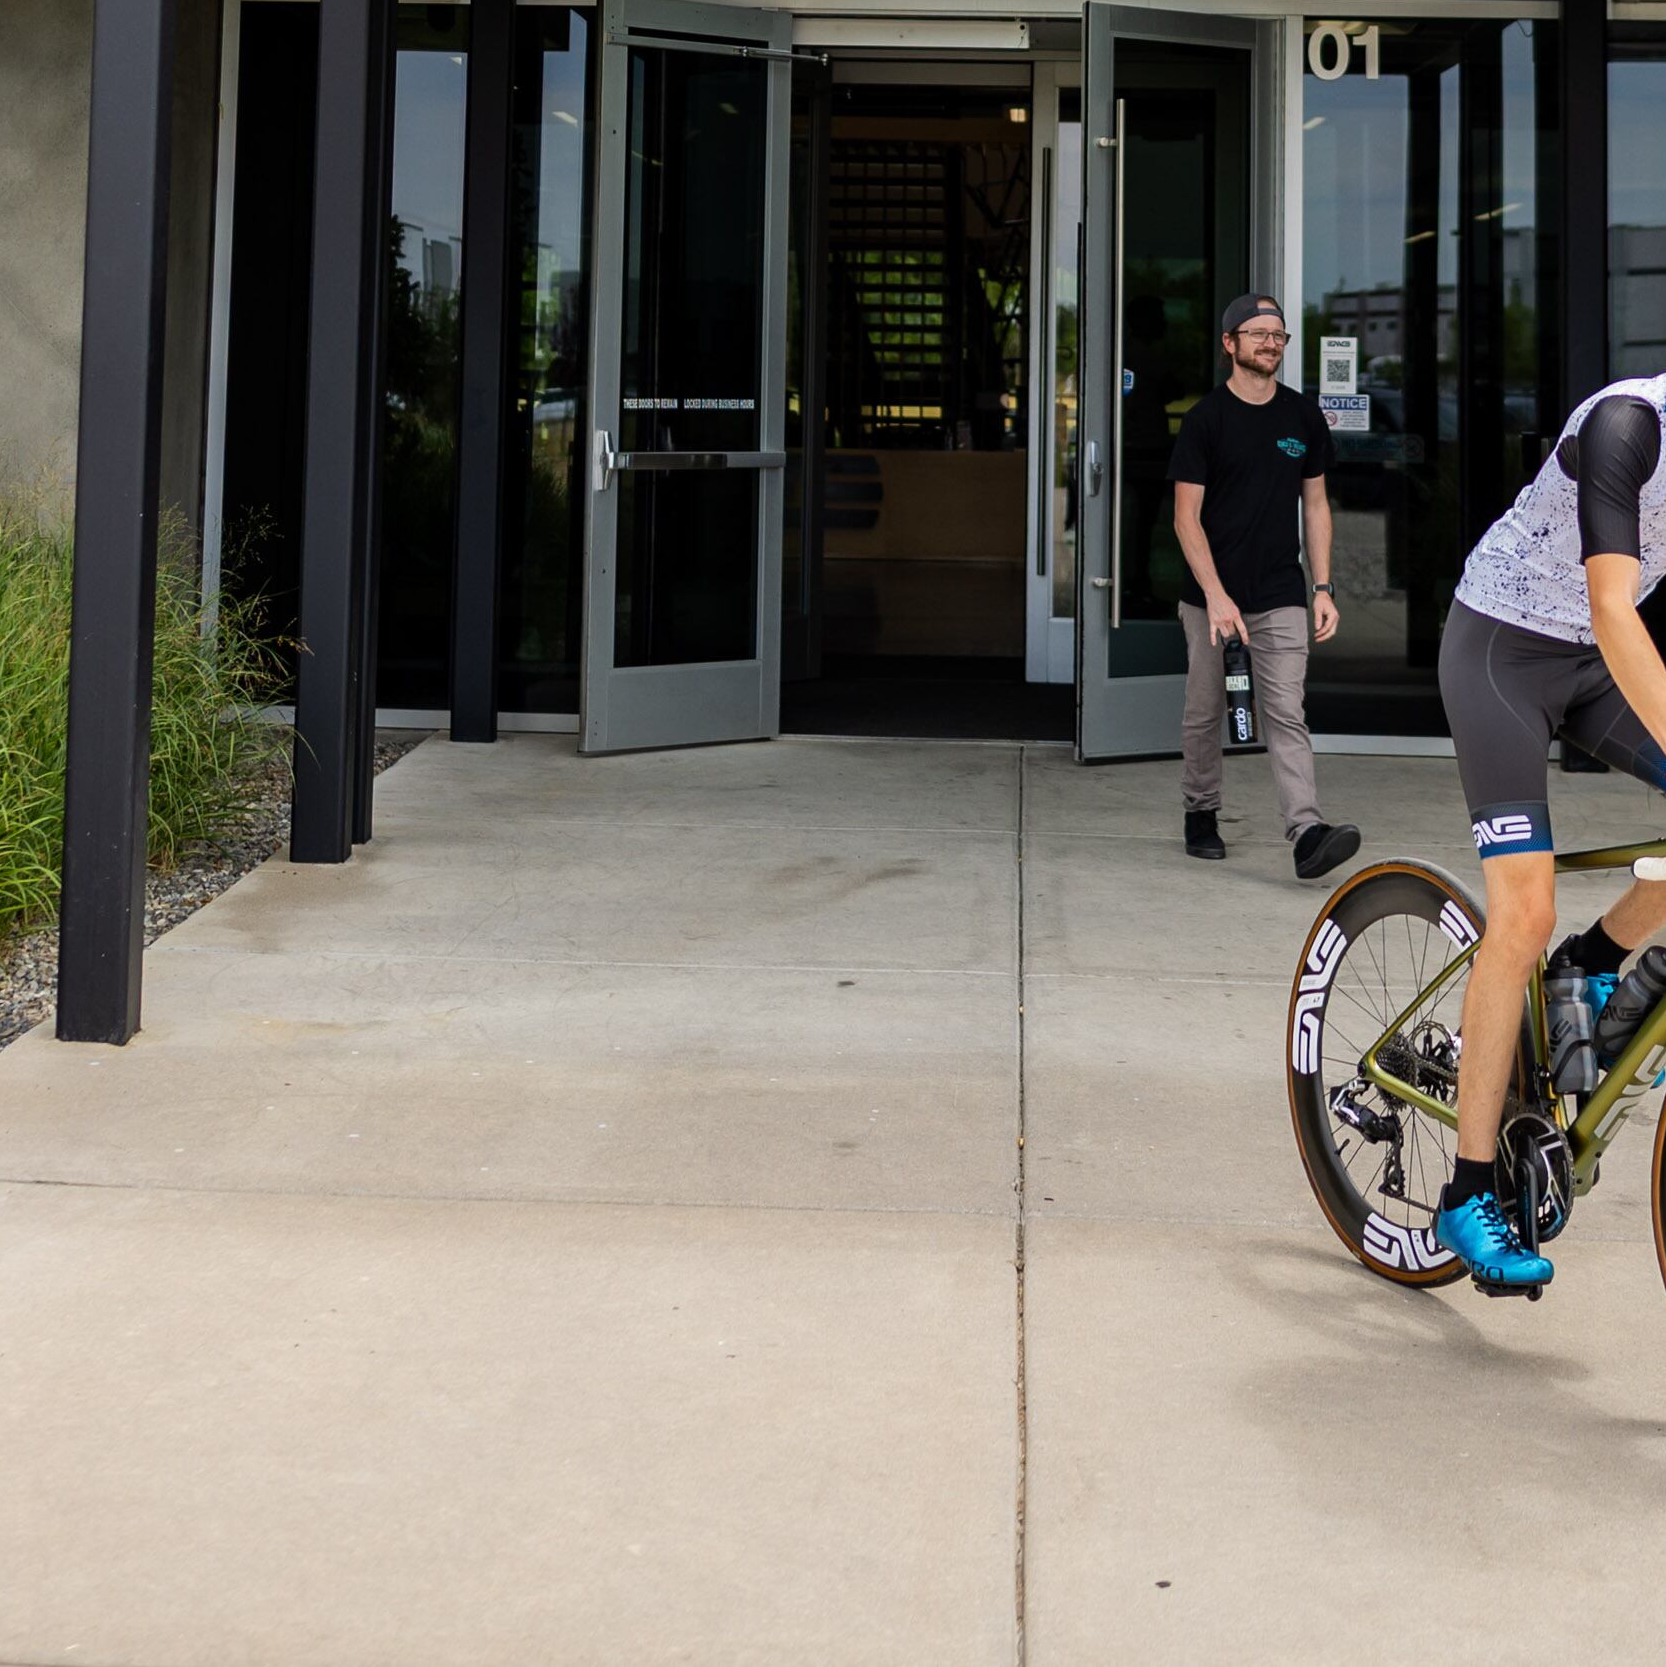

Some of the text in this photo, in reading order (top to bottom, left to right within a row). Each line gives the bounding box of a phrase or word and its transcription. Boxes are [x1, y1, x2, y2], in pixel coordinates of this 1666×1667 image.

[1307, 25, 1380, 80] 01
[623, 398, 638, 409] THESE
[639, 398, 653, 409] DOORS
[1321, 398, 1366, 409] NOTICE
[1234, 707, 1248, 741] cardo
